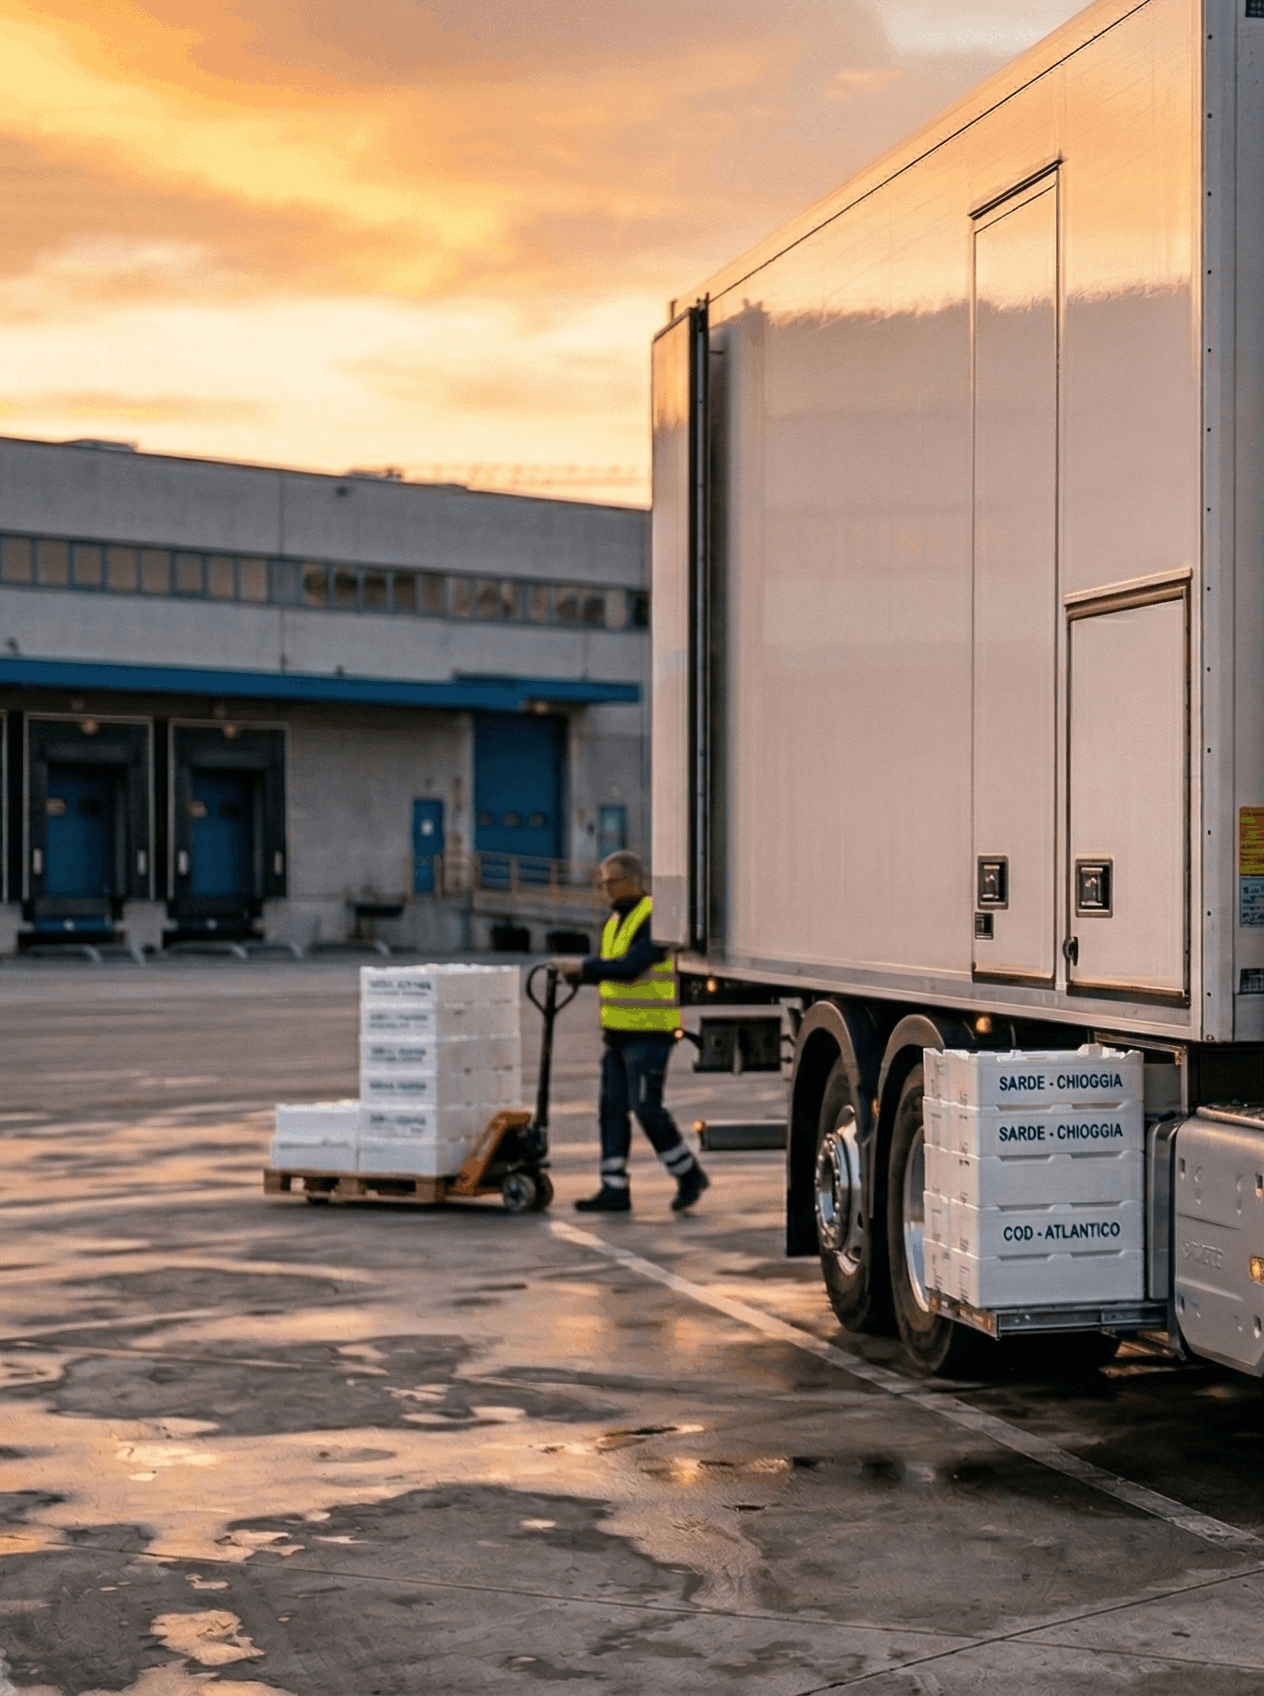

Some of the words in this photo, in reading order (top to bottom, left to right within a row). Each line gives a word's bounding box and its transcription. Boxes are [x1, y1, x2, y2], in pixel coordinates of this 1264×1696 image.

[999, 1075, 1046, 1092] SARDE
[1056, 1073, 1124, 1090] CHIOGGIA
[999, 1125, 1046, 1142] SARDE
[1056, 1123, 1124, 1140] CHIOGGIA
[1003, 1225, 1034, 1242] COD
[1044, 1222, 1121, 1240] ATLANTICO
